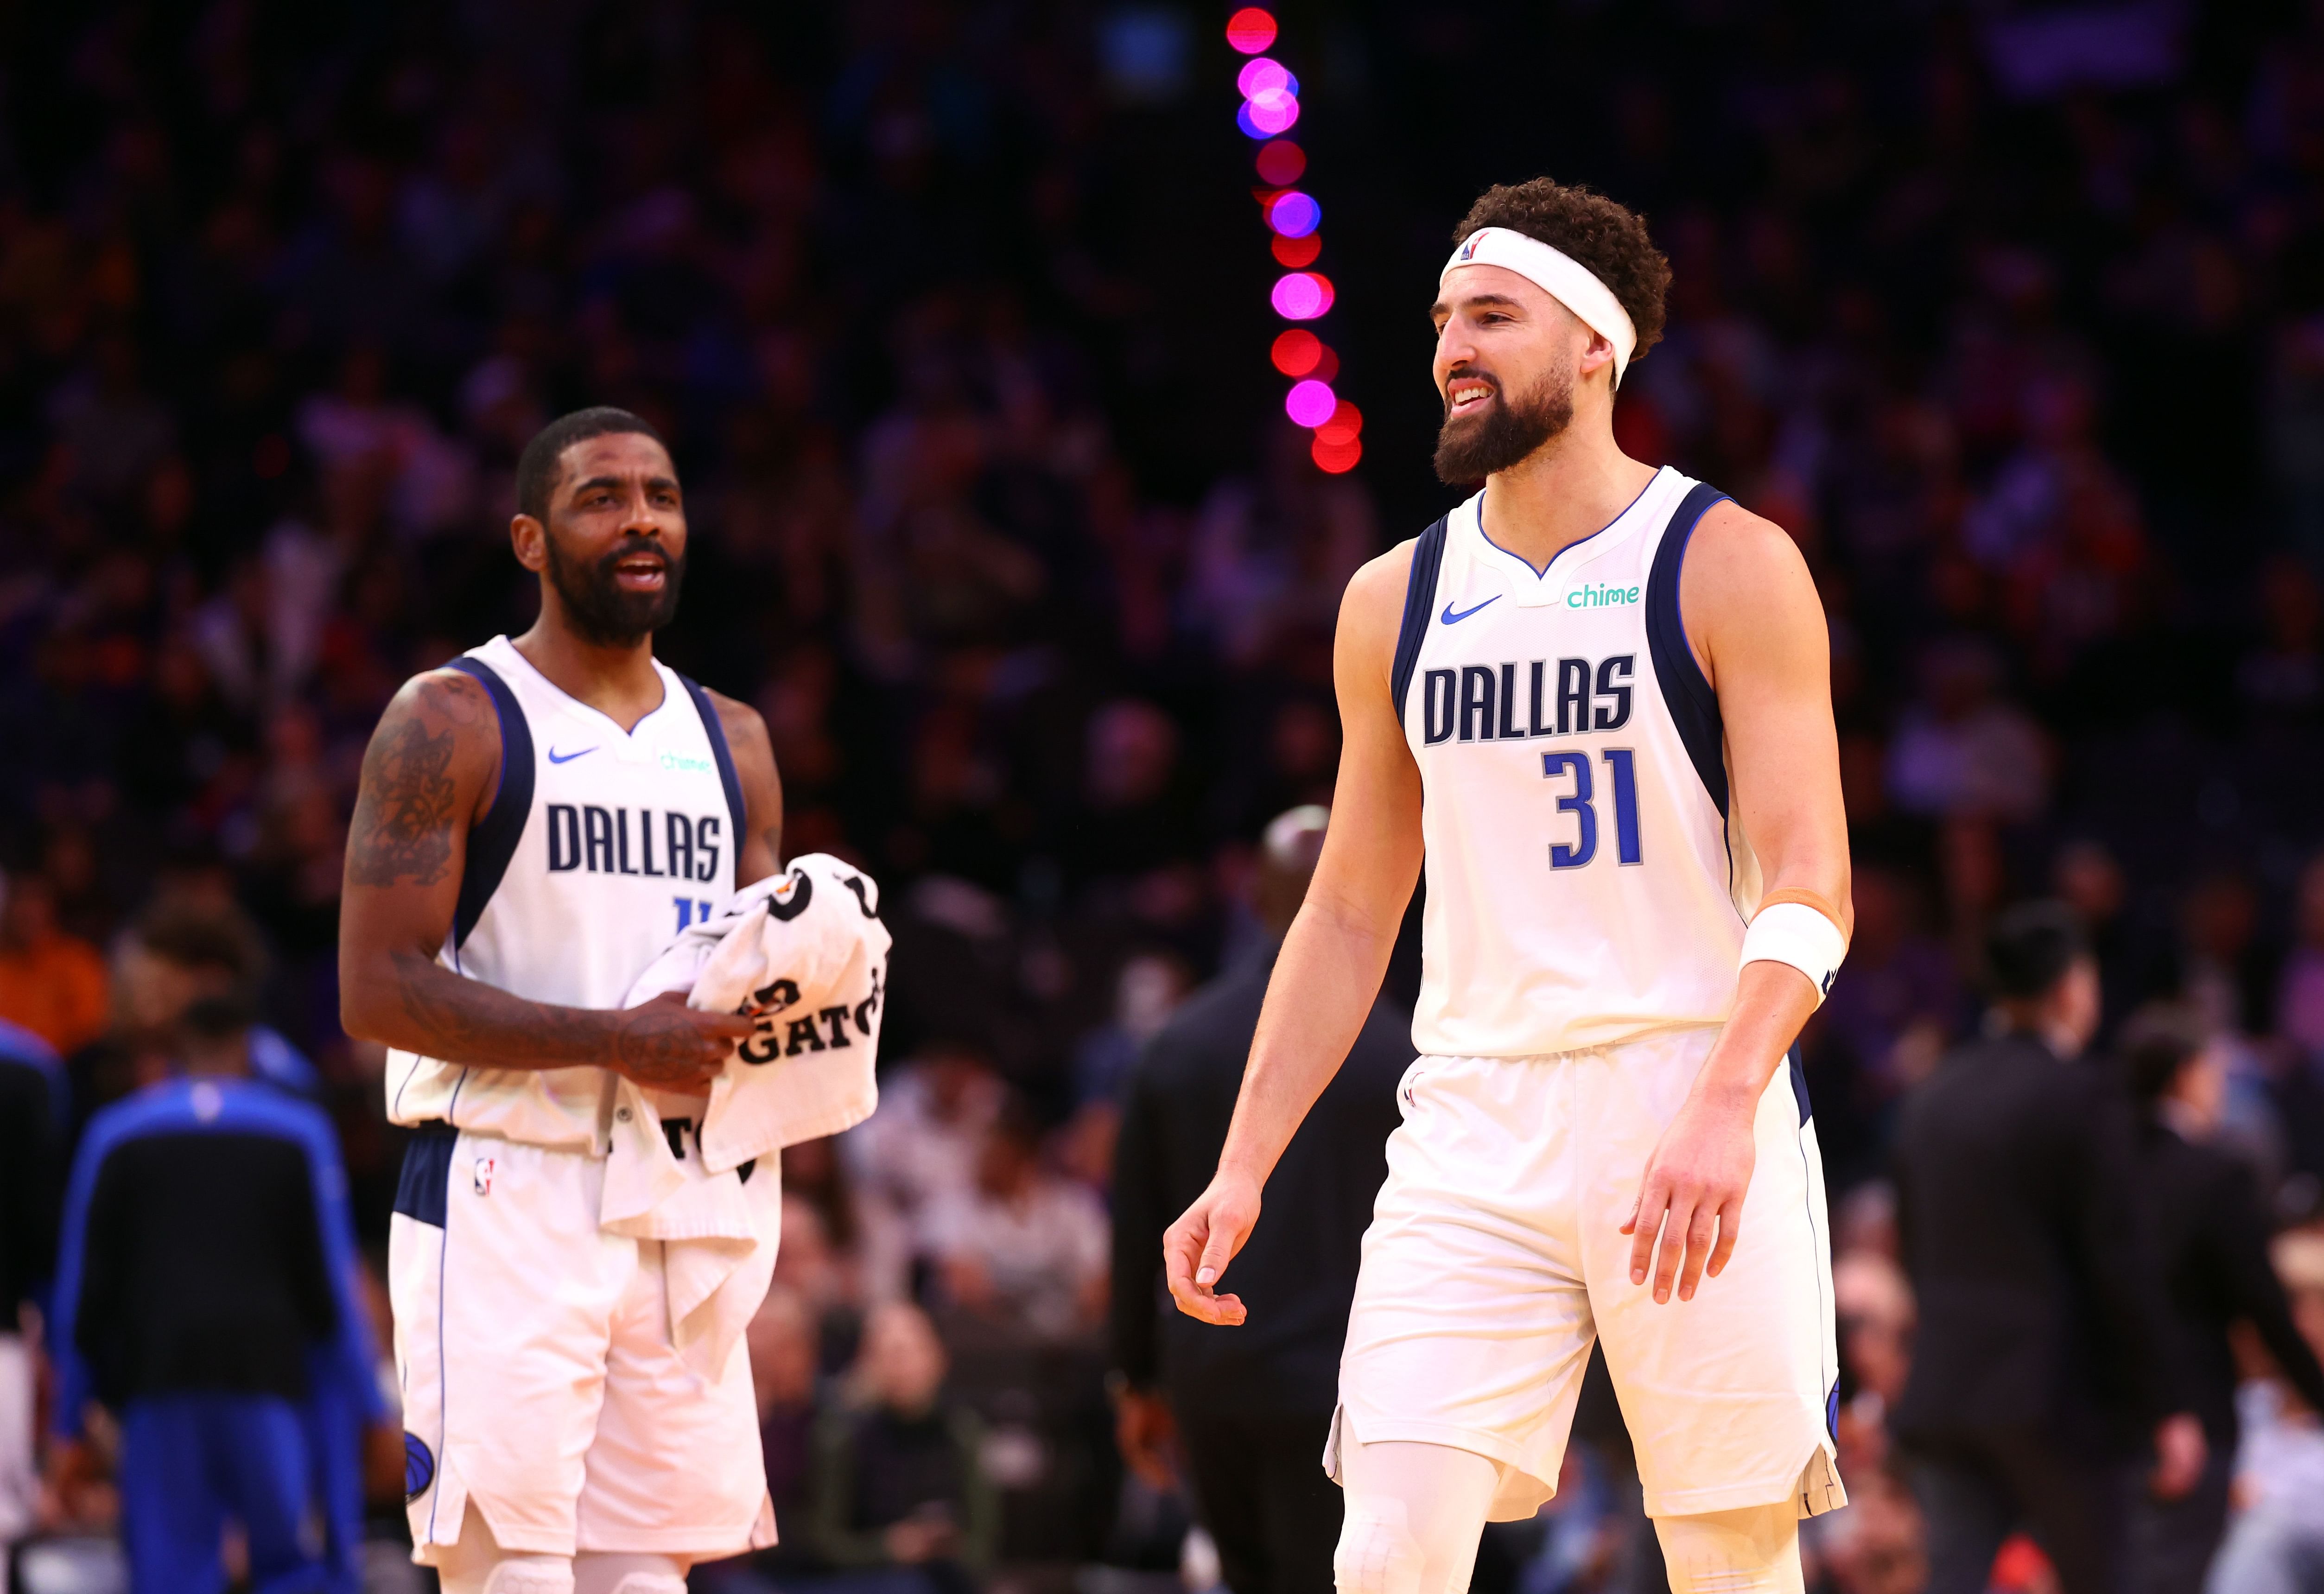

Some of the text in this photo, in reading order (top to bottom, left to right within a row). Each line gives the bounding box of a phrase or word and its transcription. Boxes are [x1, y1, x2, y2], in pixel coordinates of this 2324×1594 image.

[1568, 584, 1639, 608] chime
[1423, 652, 1637, 748] DALLAS
[546, 804, 719, 883] DALLAS
[1541, 747, 1644, 870] 31
